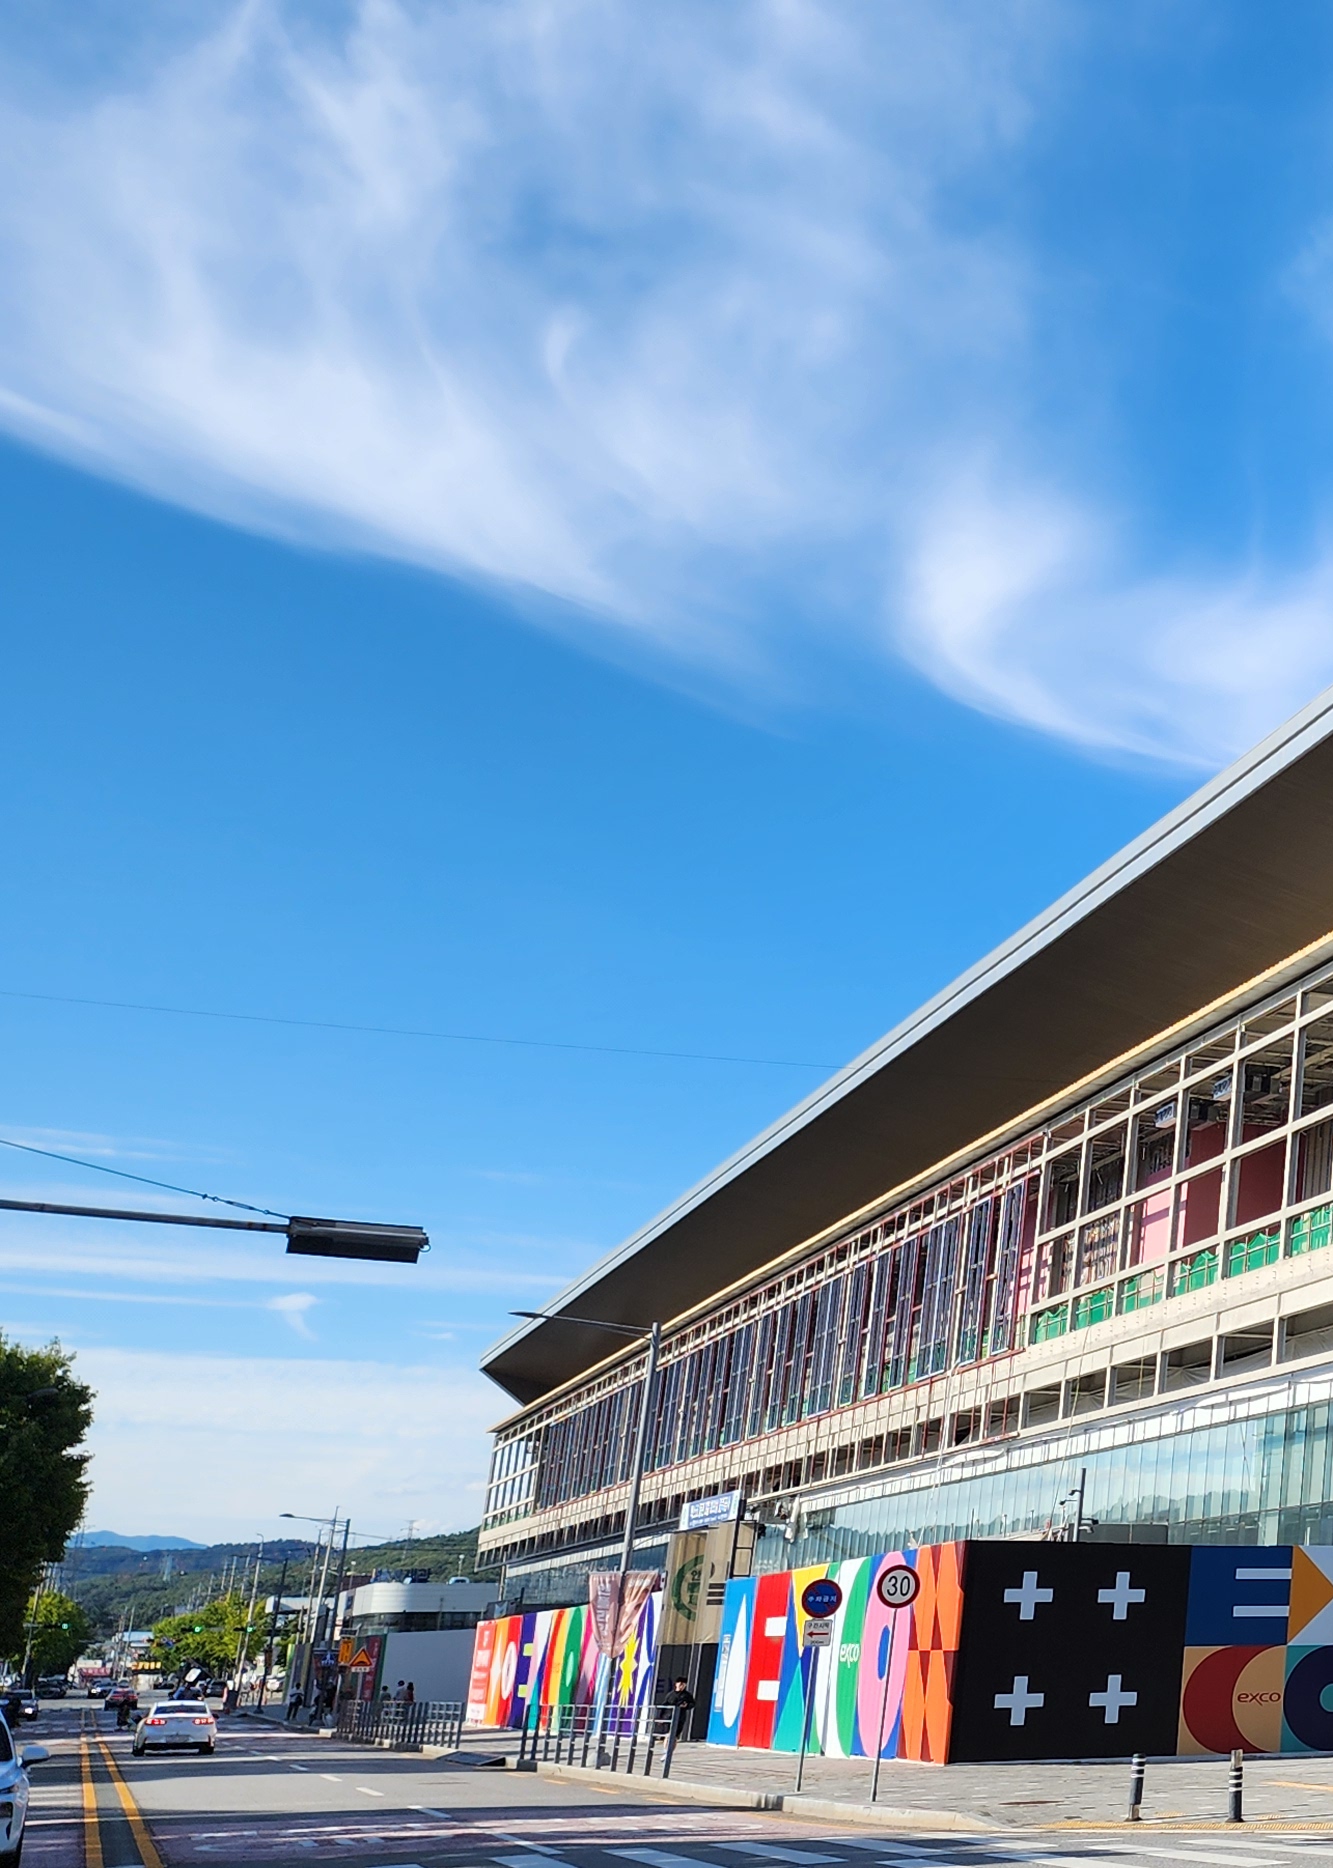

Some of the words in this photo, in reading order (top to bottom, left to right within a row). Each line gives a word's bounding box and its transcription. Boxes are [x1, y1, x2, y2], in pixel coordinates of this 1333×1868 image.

[886, 1575, 911, 1597] 30
[807, 1594, 838, 1604] 주차금지
[840, 1643, 860, 1668] exco
[1237, 1692, 1281, 1706] exco
